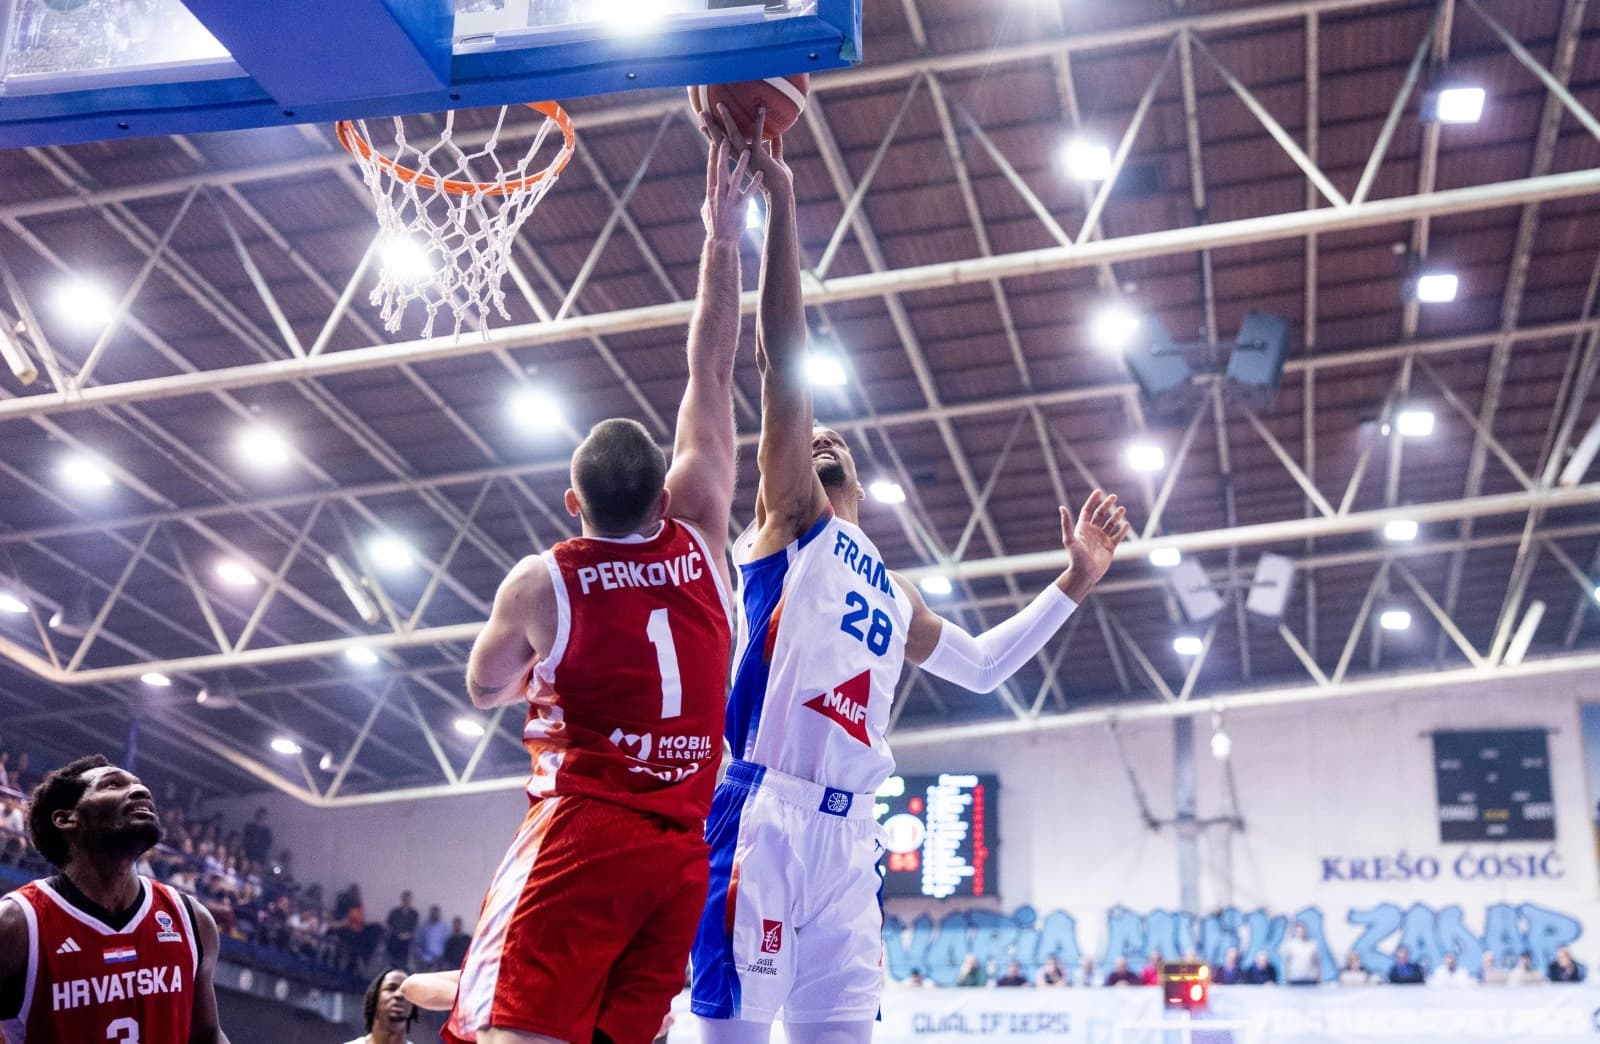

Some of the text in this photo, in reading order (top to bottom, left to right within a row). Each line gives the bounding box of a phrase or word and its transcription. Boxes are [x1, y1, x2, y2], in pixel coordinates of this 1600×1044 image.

[577, 541, 703, 595] PERKOVIĆ
[840, 590, 893, 657] 28
[646, 607, 683, 720] 1
[822, 688, 868, 725] MAIF
[659, 735, 712, 750] MOBIL
[1321, 850, 1440, 881] KREŠO
[52, 965, 183, 1011] HRVATSKA
[106, 1016, 140, 1044] 3
[913, 1010, 1072, 1035] QUALIFIERS
